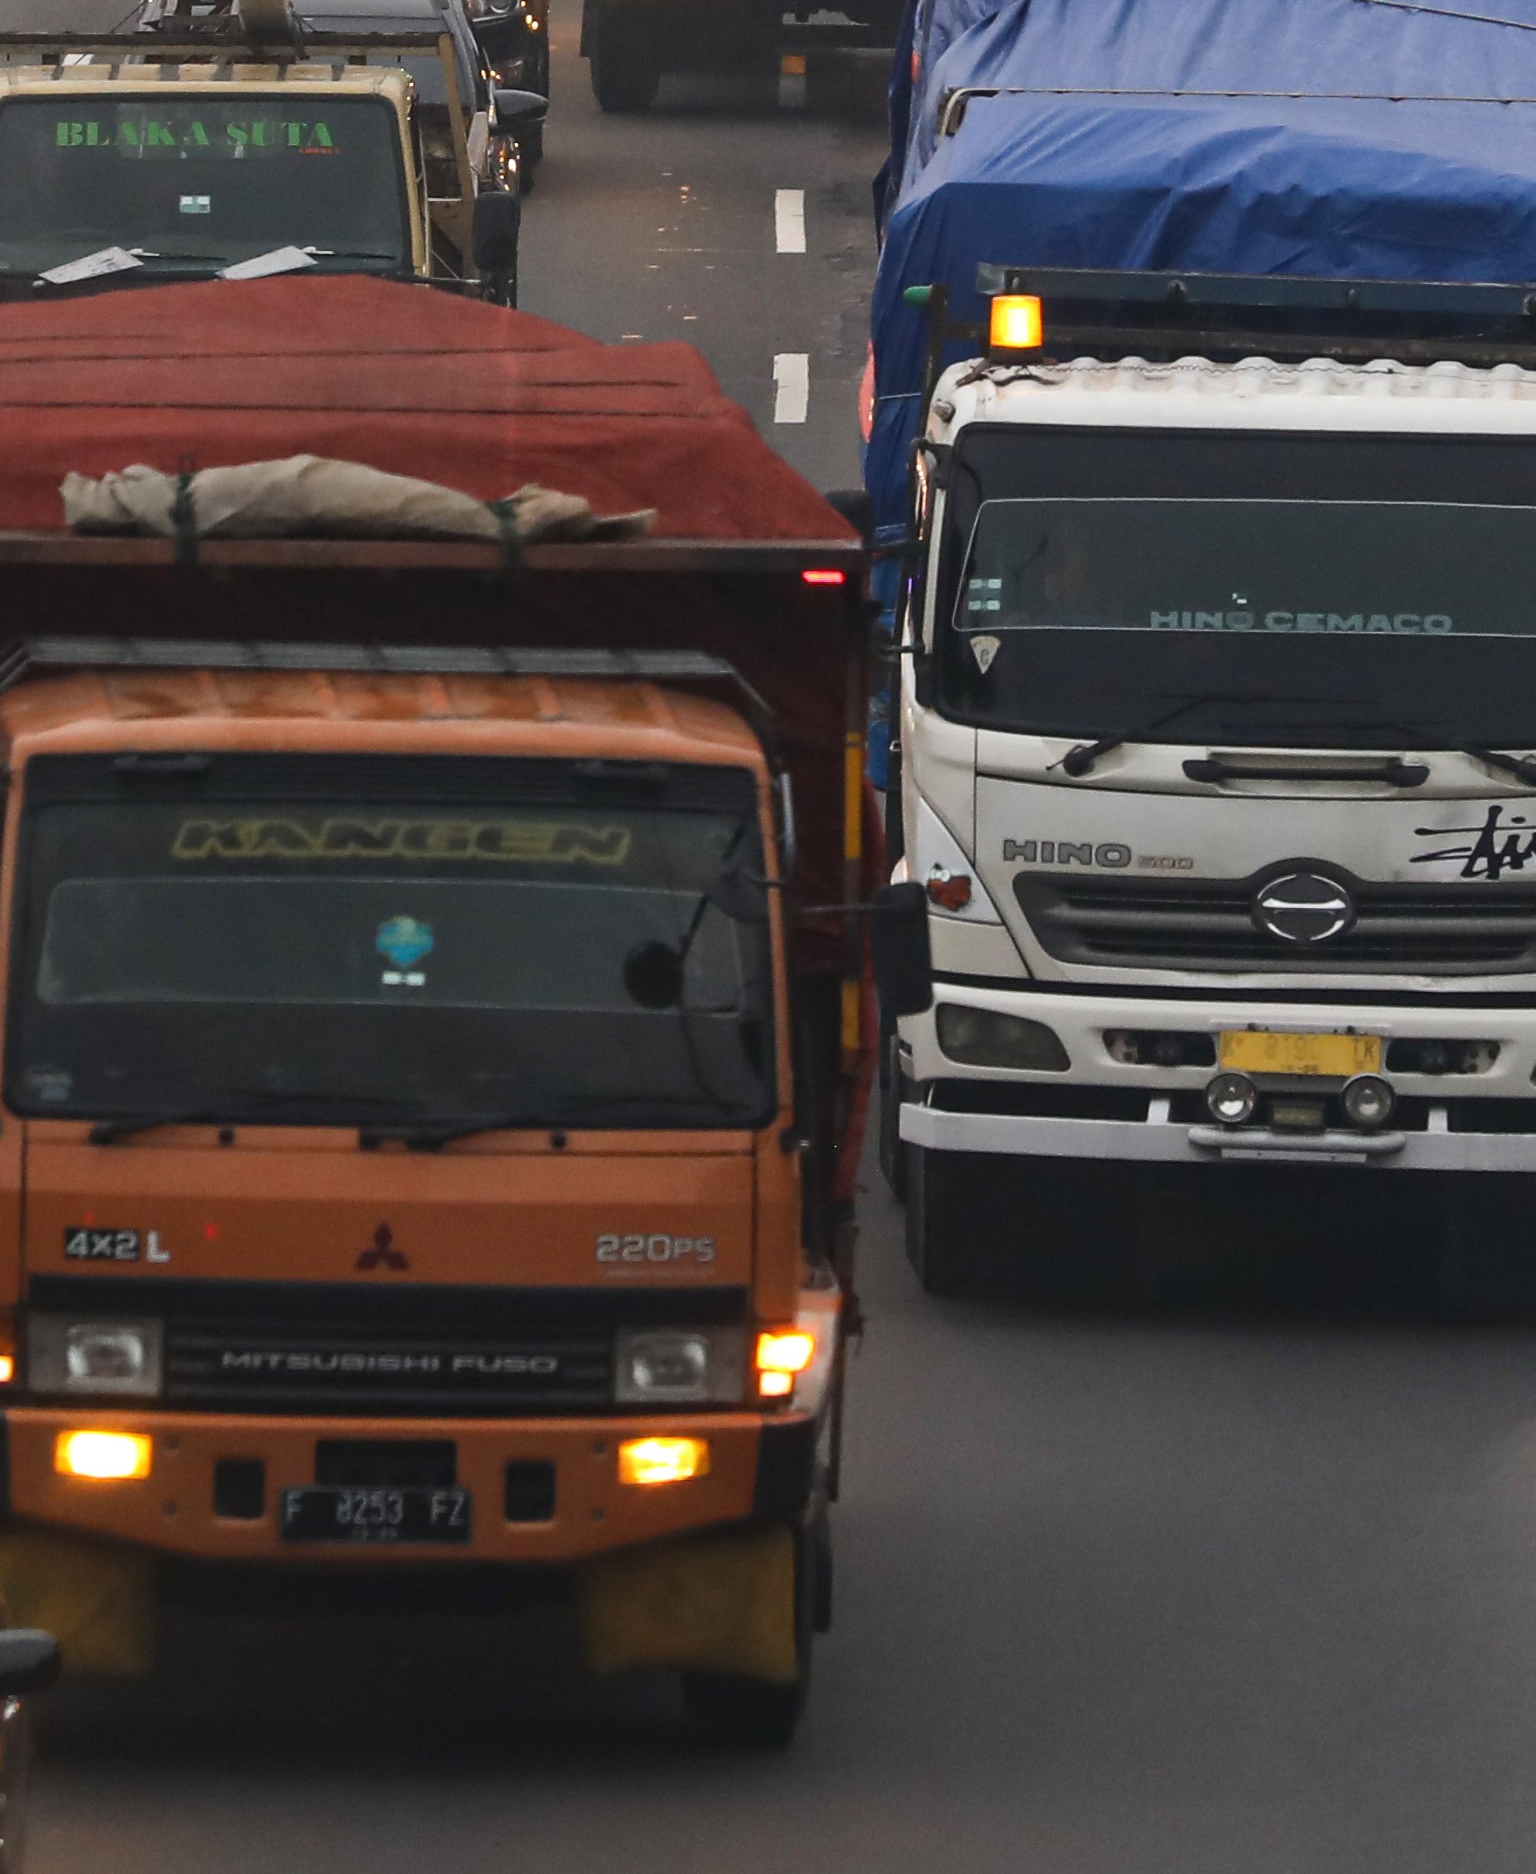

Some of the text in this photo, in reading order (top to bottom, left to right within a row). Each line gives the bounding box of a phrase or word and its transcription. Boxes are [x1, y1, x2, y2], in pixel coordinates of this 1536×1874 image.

[55, 121, 334, 147] BLAKA SUTA
[1150, 611, 1254, 630] HINO
[171, 819, 631, 866] KANGEN
[1003, 838, 1132, 868] HINO
[221, 1351, 559, 1374] MITSUBISHI FUSO
[286, 1491, 304, 1523] F
[430, 1491, 465, 1526] FZ
